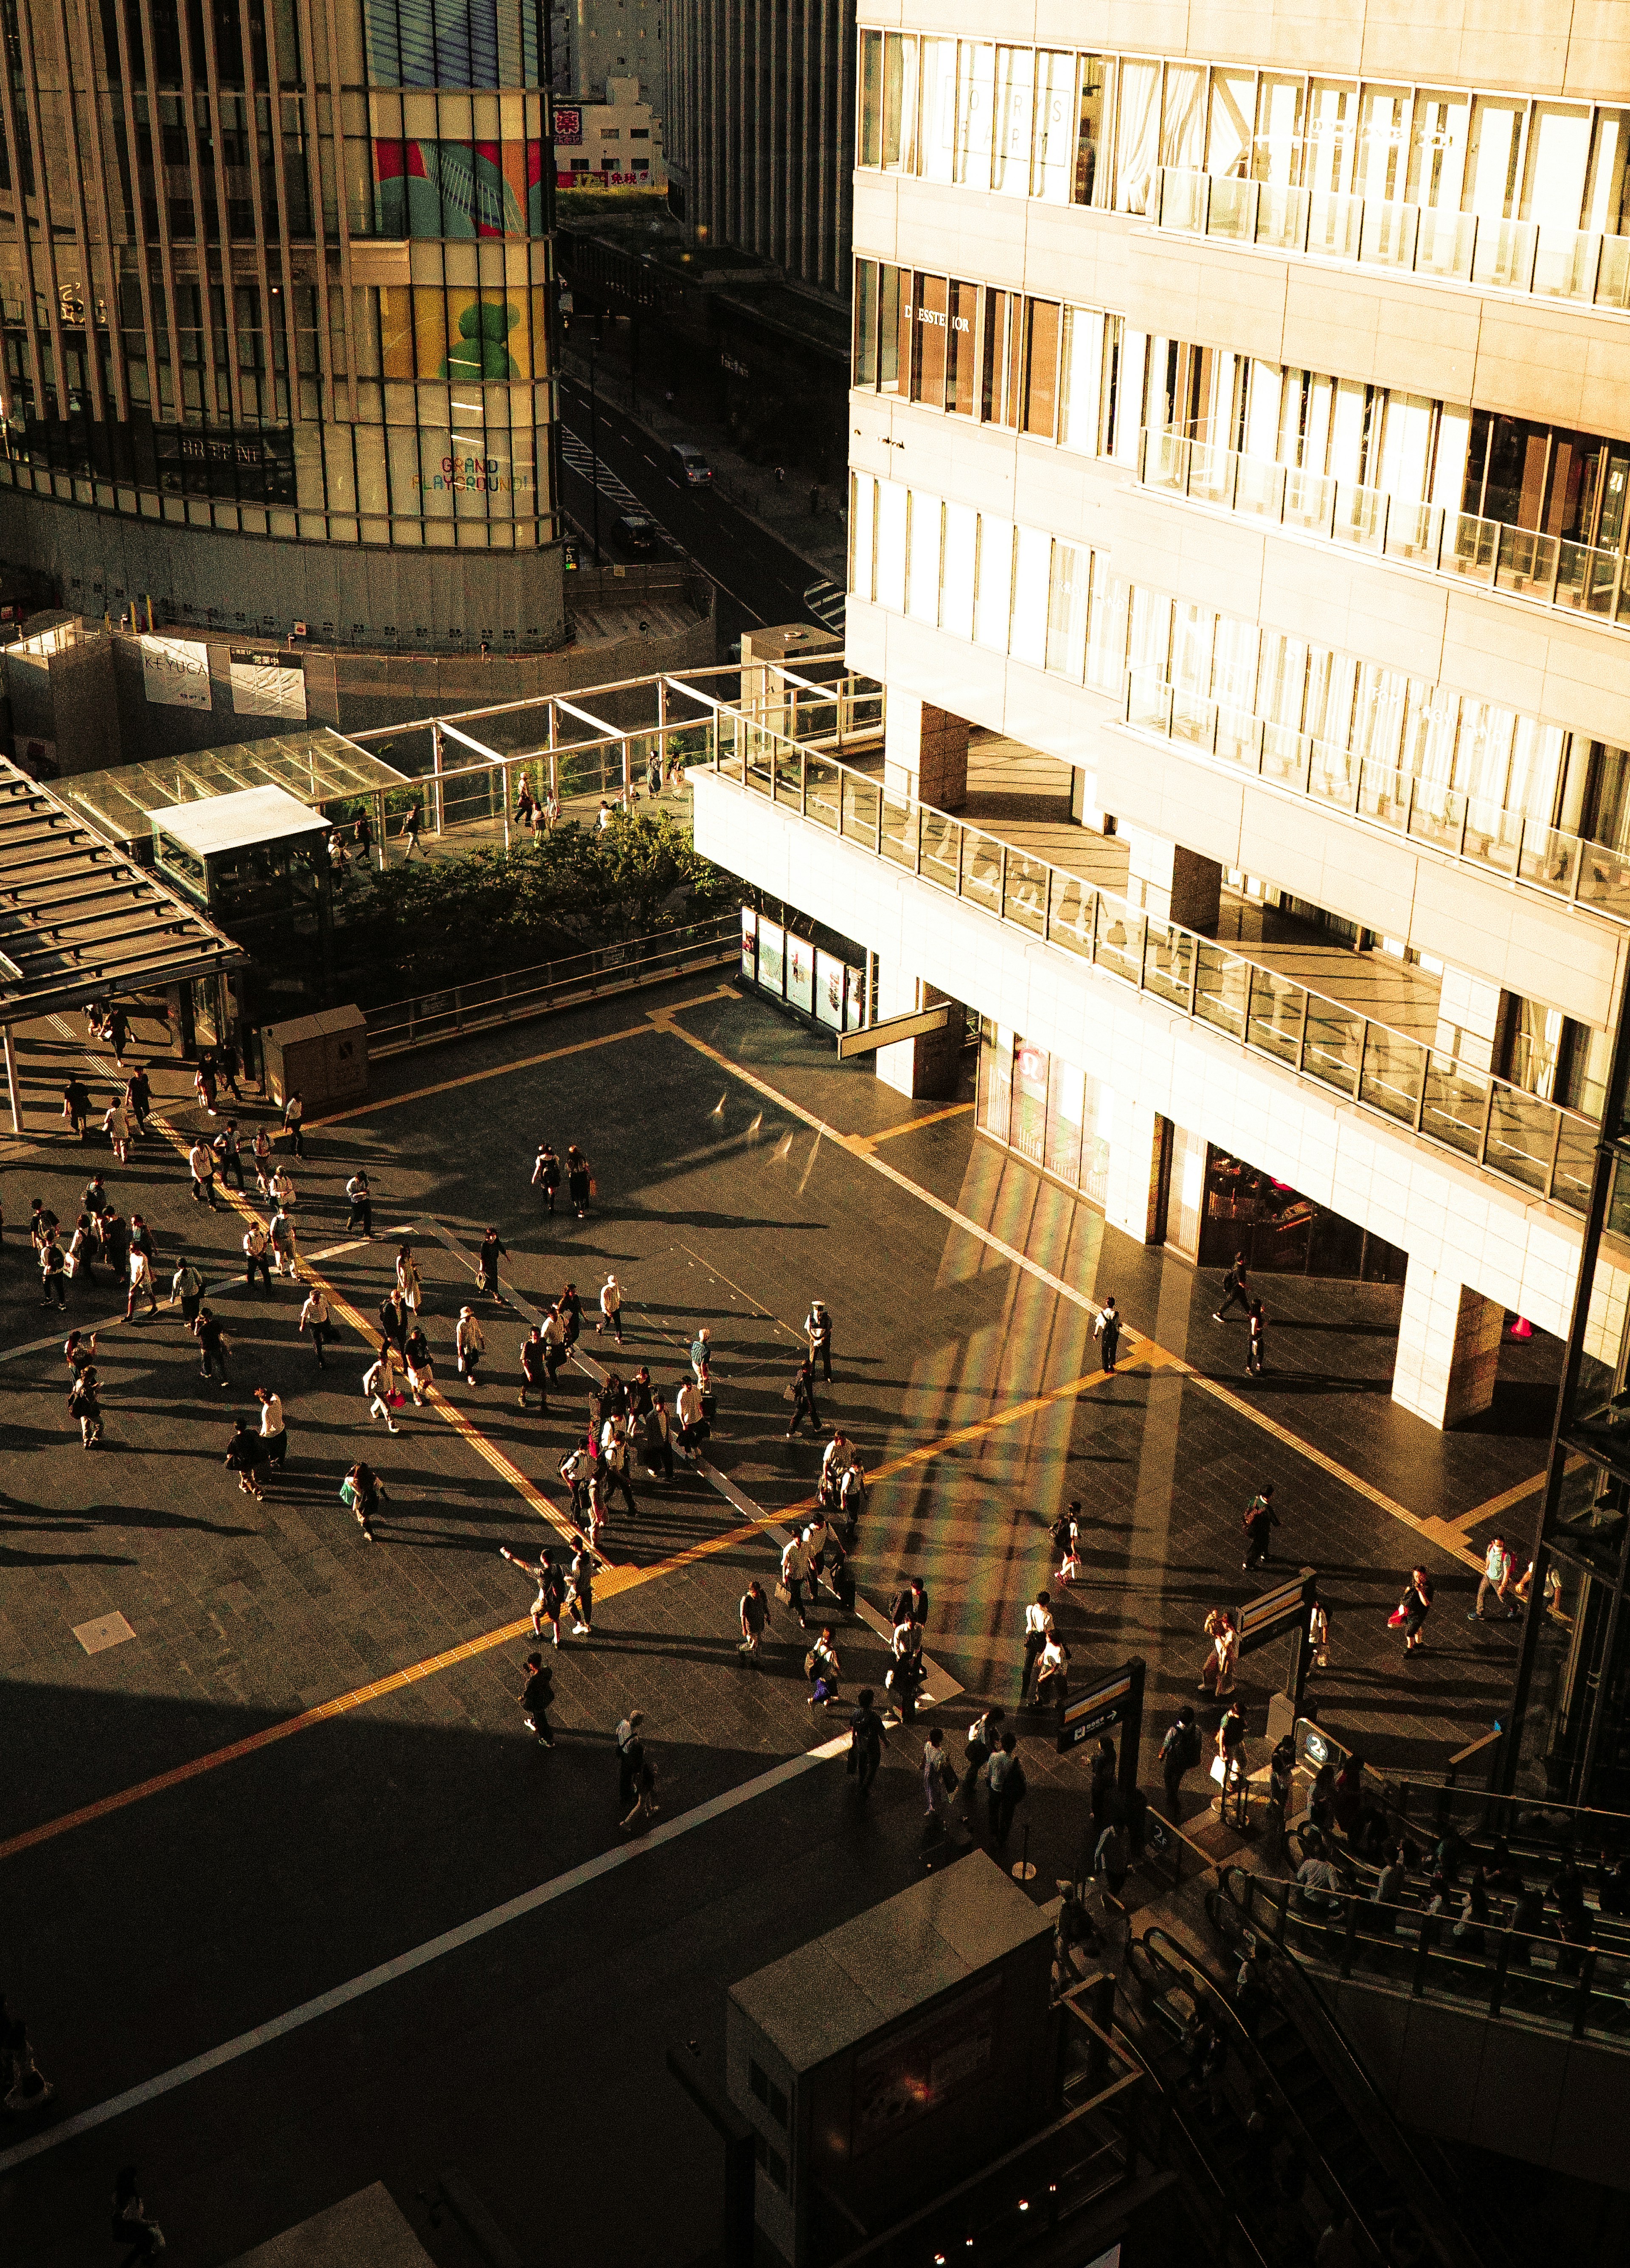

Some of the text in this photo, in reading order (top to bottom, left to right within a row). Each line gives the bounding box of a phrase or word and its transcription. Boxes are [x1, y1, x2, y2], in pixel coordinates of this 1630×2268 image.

[554, 110, 579, 134] 薬
[441, 457, 498, 473] GRAND
[145, 656, 208, 677] KEYUCA
[1310, 1736, 1326, 1757] 2F
